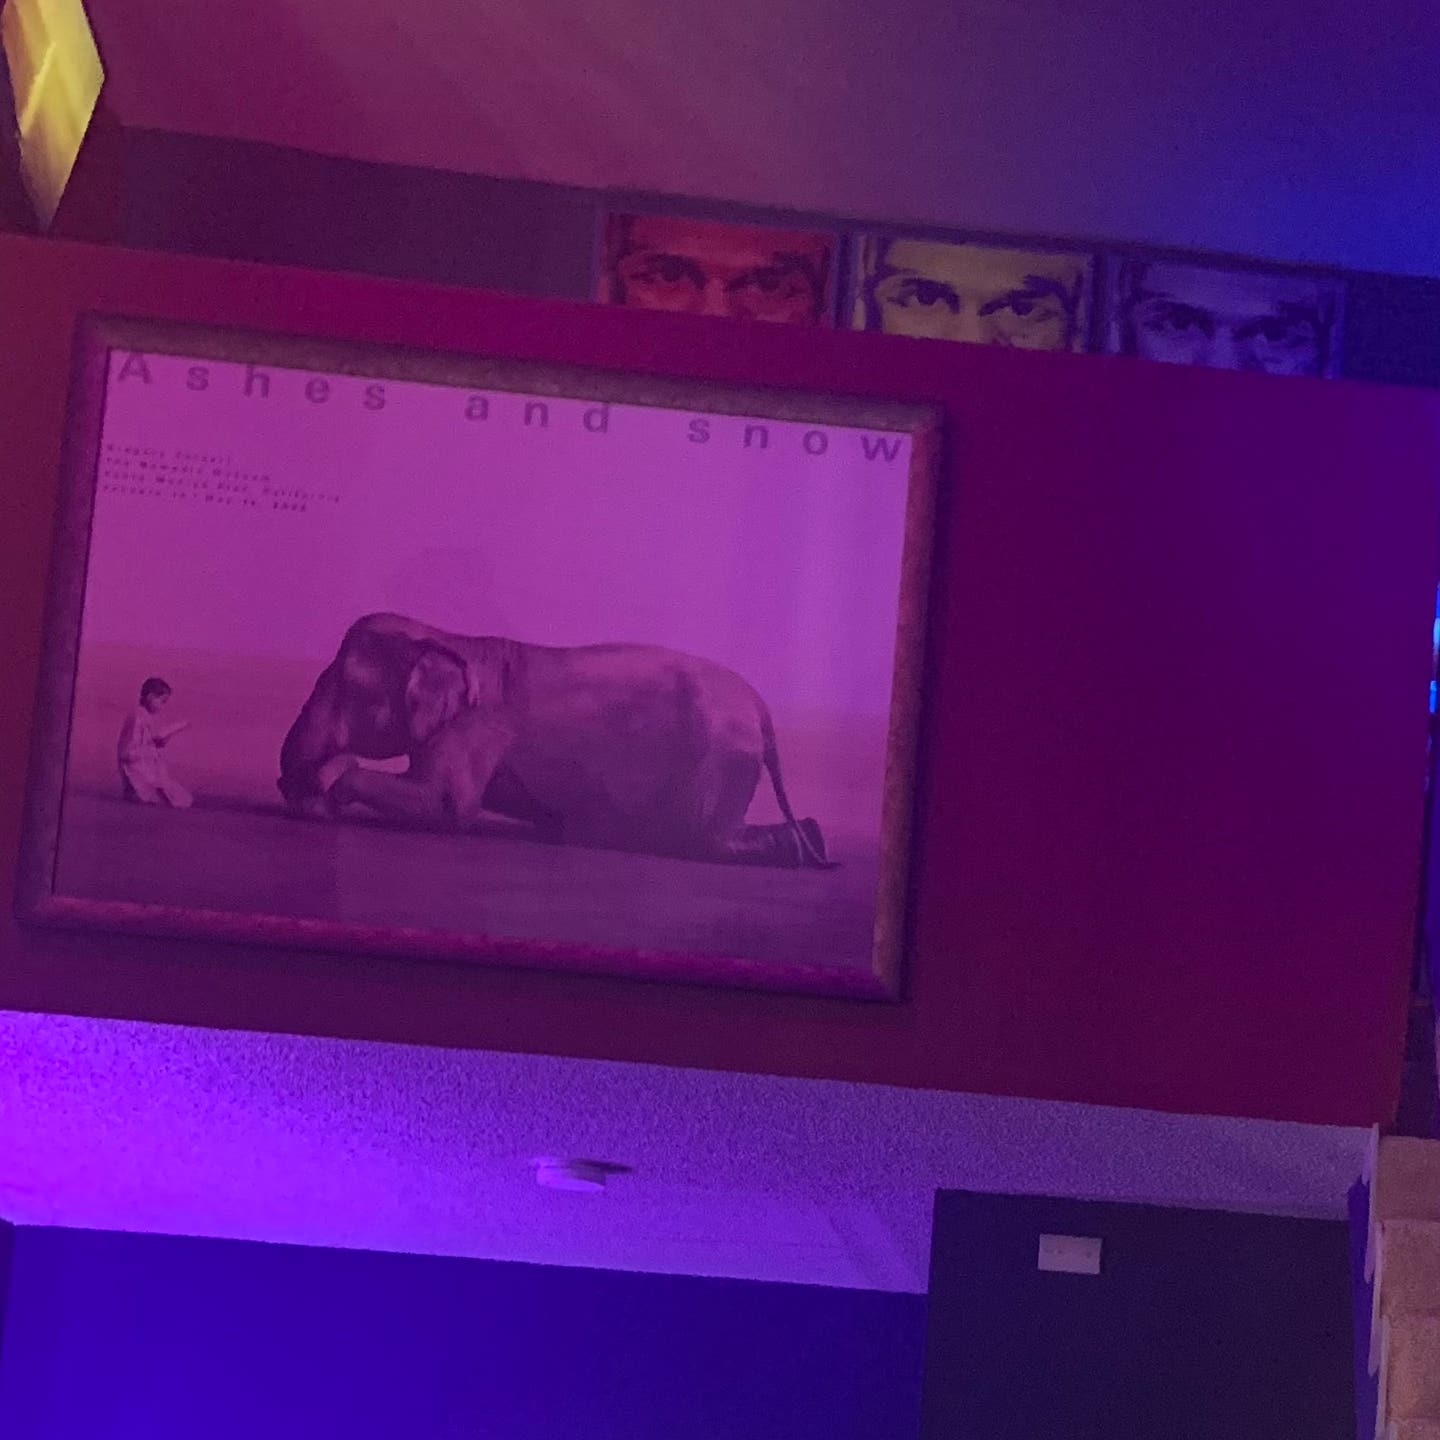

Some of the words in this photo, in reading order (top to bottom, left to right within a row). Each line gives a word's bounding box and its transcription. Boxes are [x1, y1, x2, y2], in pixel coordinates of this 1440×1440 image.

[116, 351, 386, 411] Ashes
[464, 393, 611, 434] and
[688, 416, 902, 462] snow
